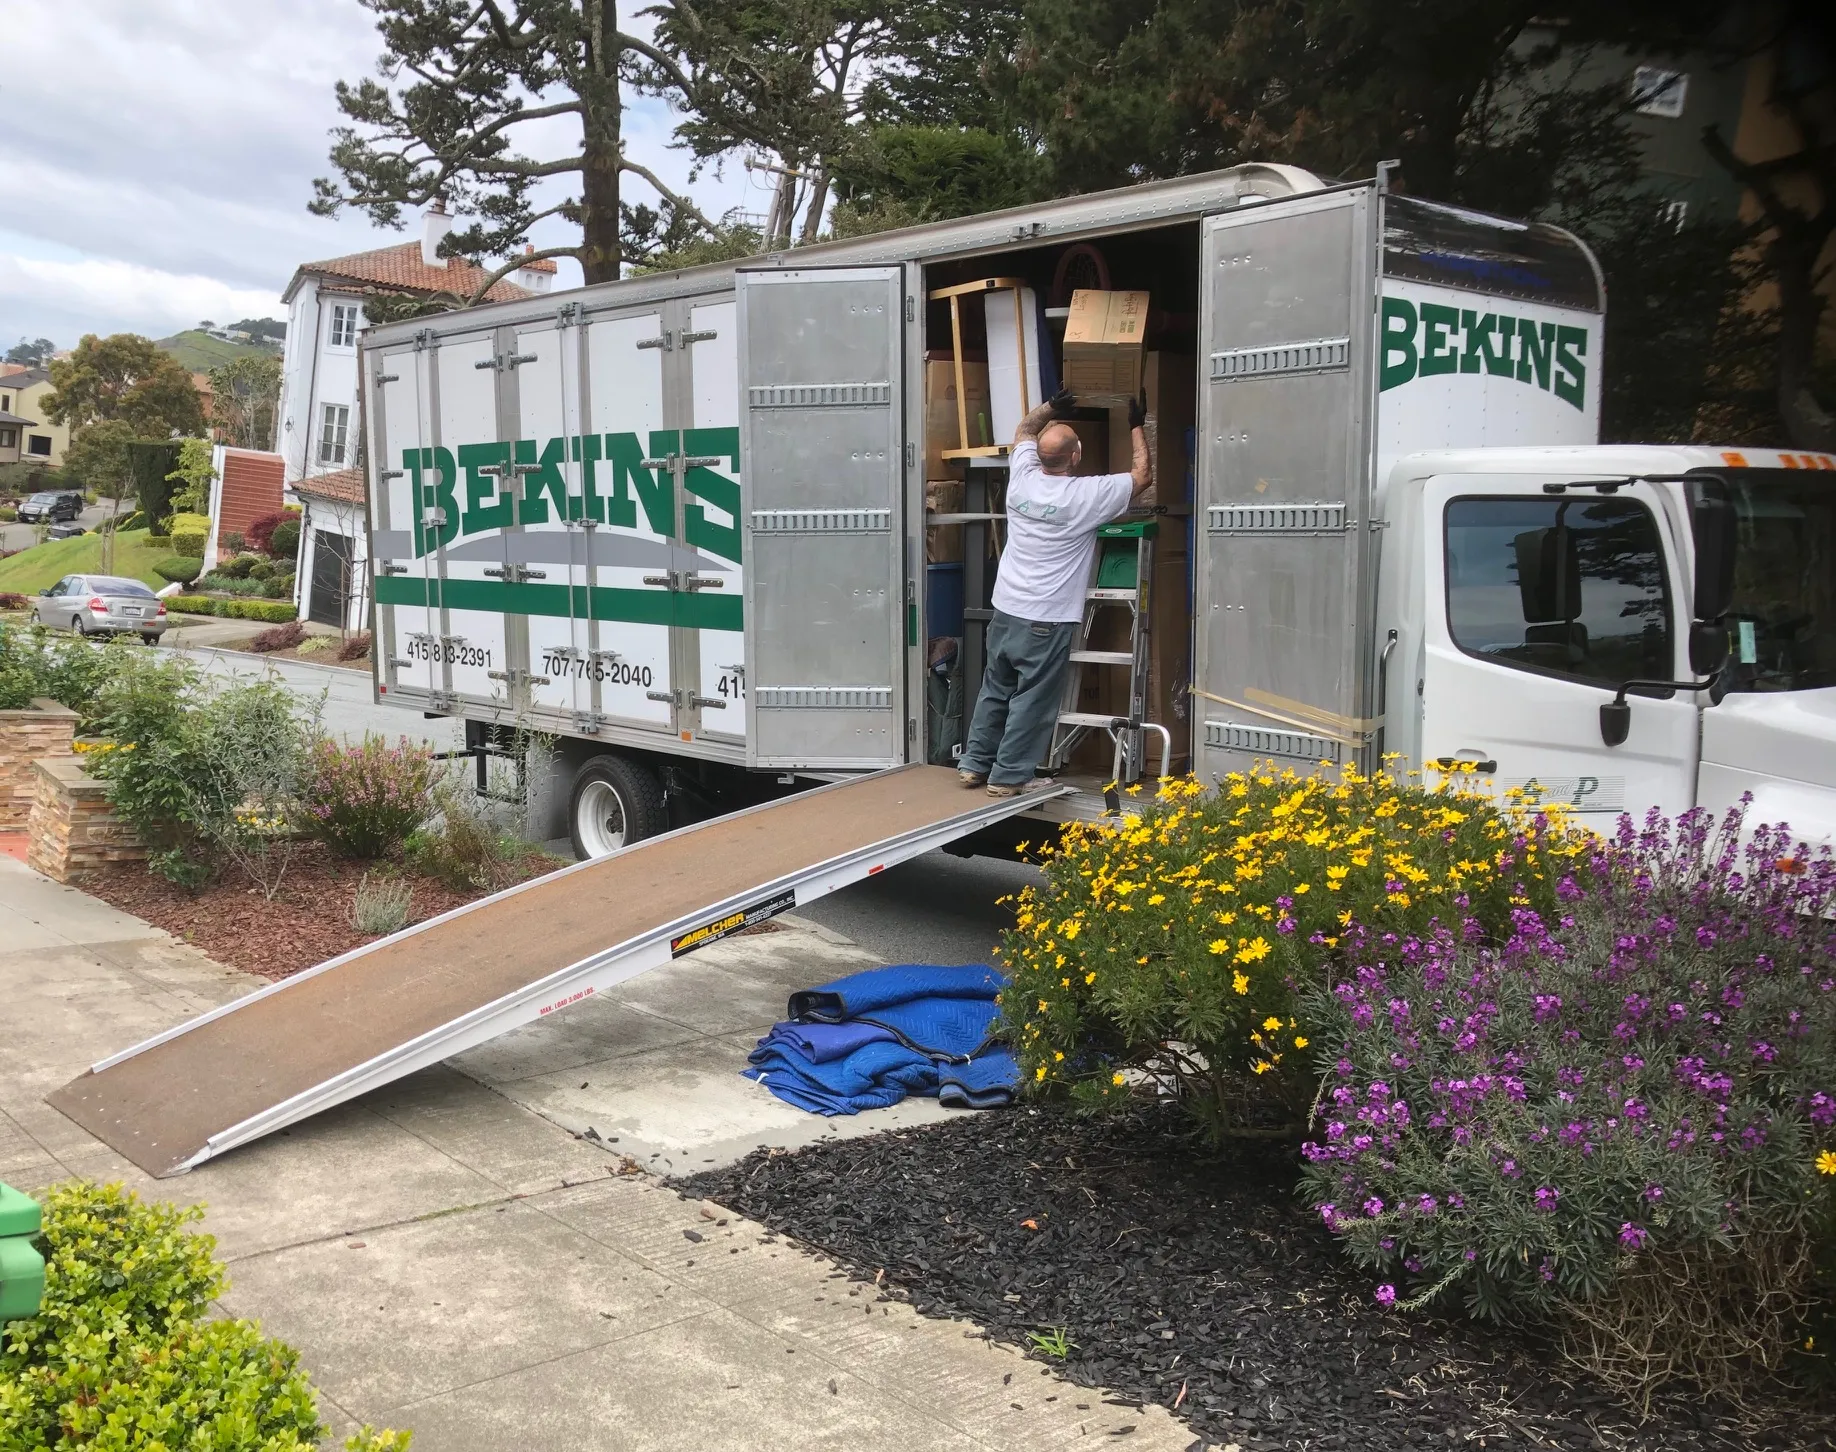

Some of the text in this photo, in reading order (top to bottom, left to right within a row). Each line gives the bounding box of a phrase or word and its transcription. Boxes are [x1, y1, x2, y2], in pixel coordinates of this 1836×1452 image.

[1380, 296, 1588, 413] BEKINS
[402, 427, 743, 565] BEKINS
[1015, 500, 1030, 513] A
[1041, 504, 1058, 518] P
[1510, 777, 1542, 806] A
[1571, 777, 1599, 805] P
[686, 912, 745, 943] MELCHER
